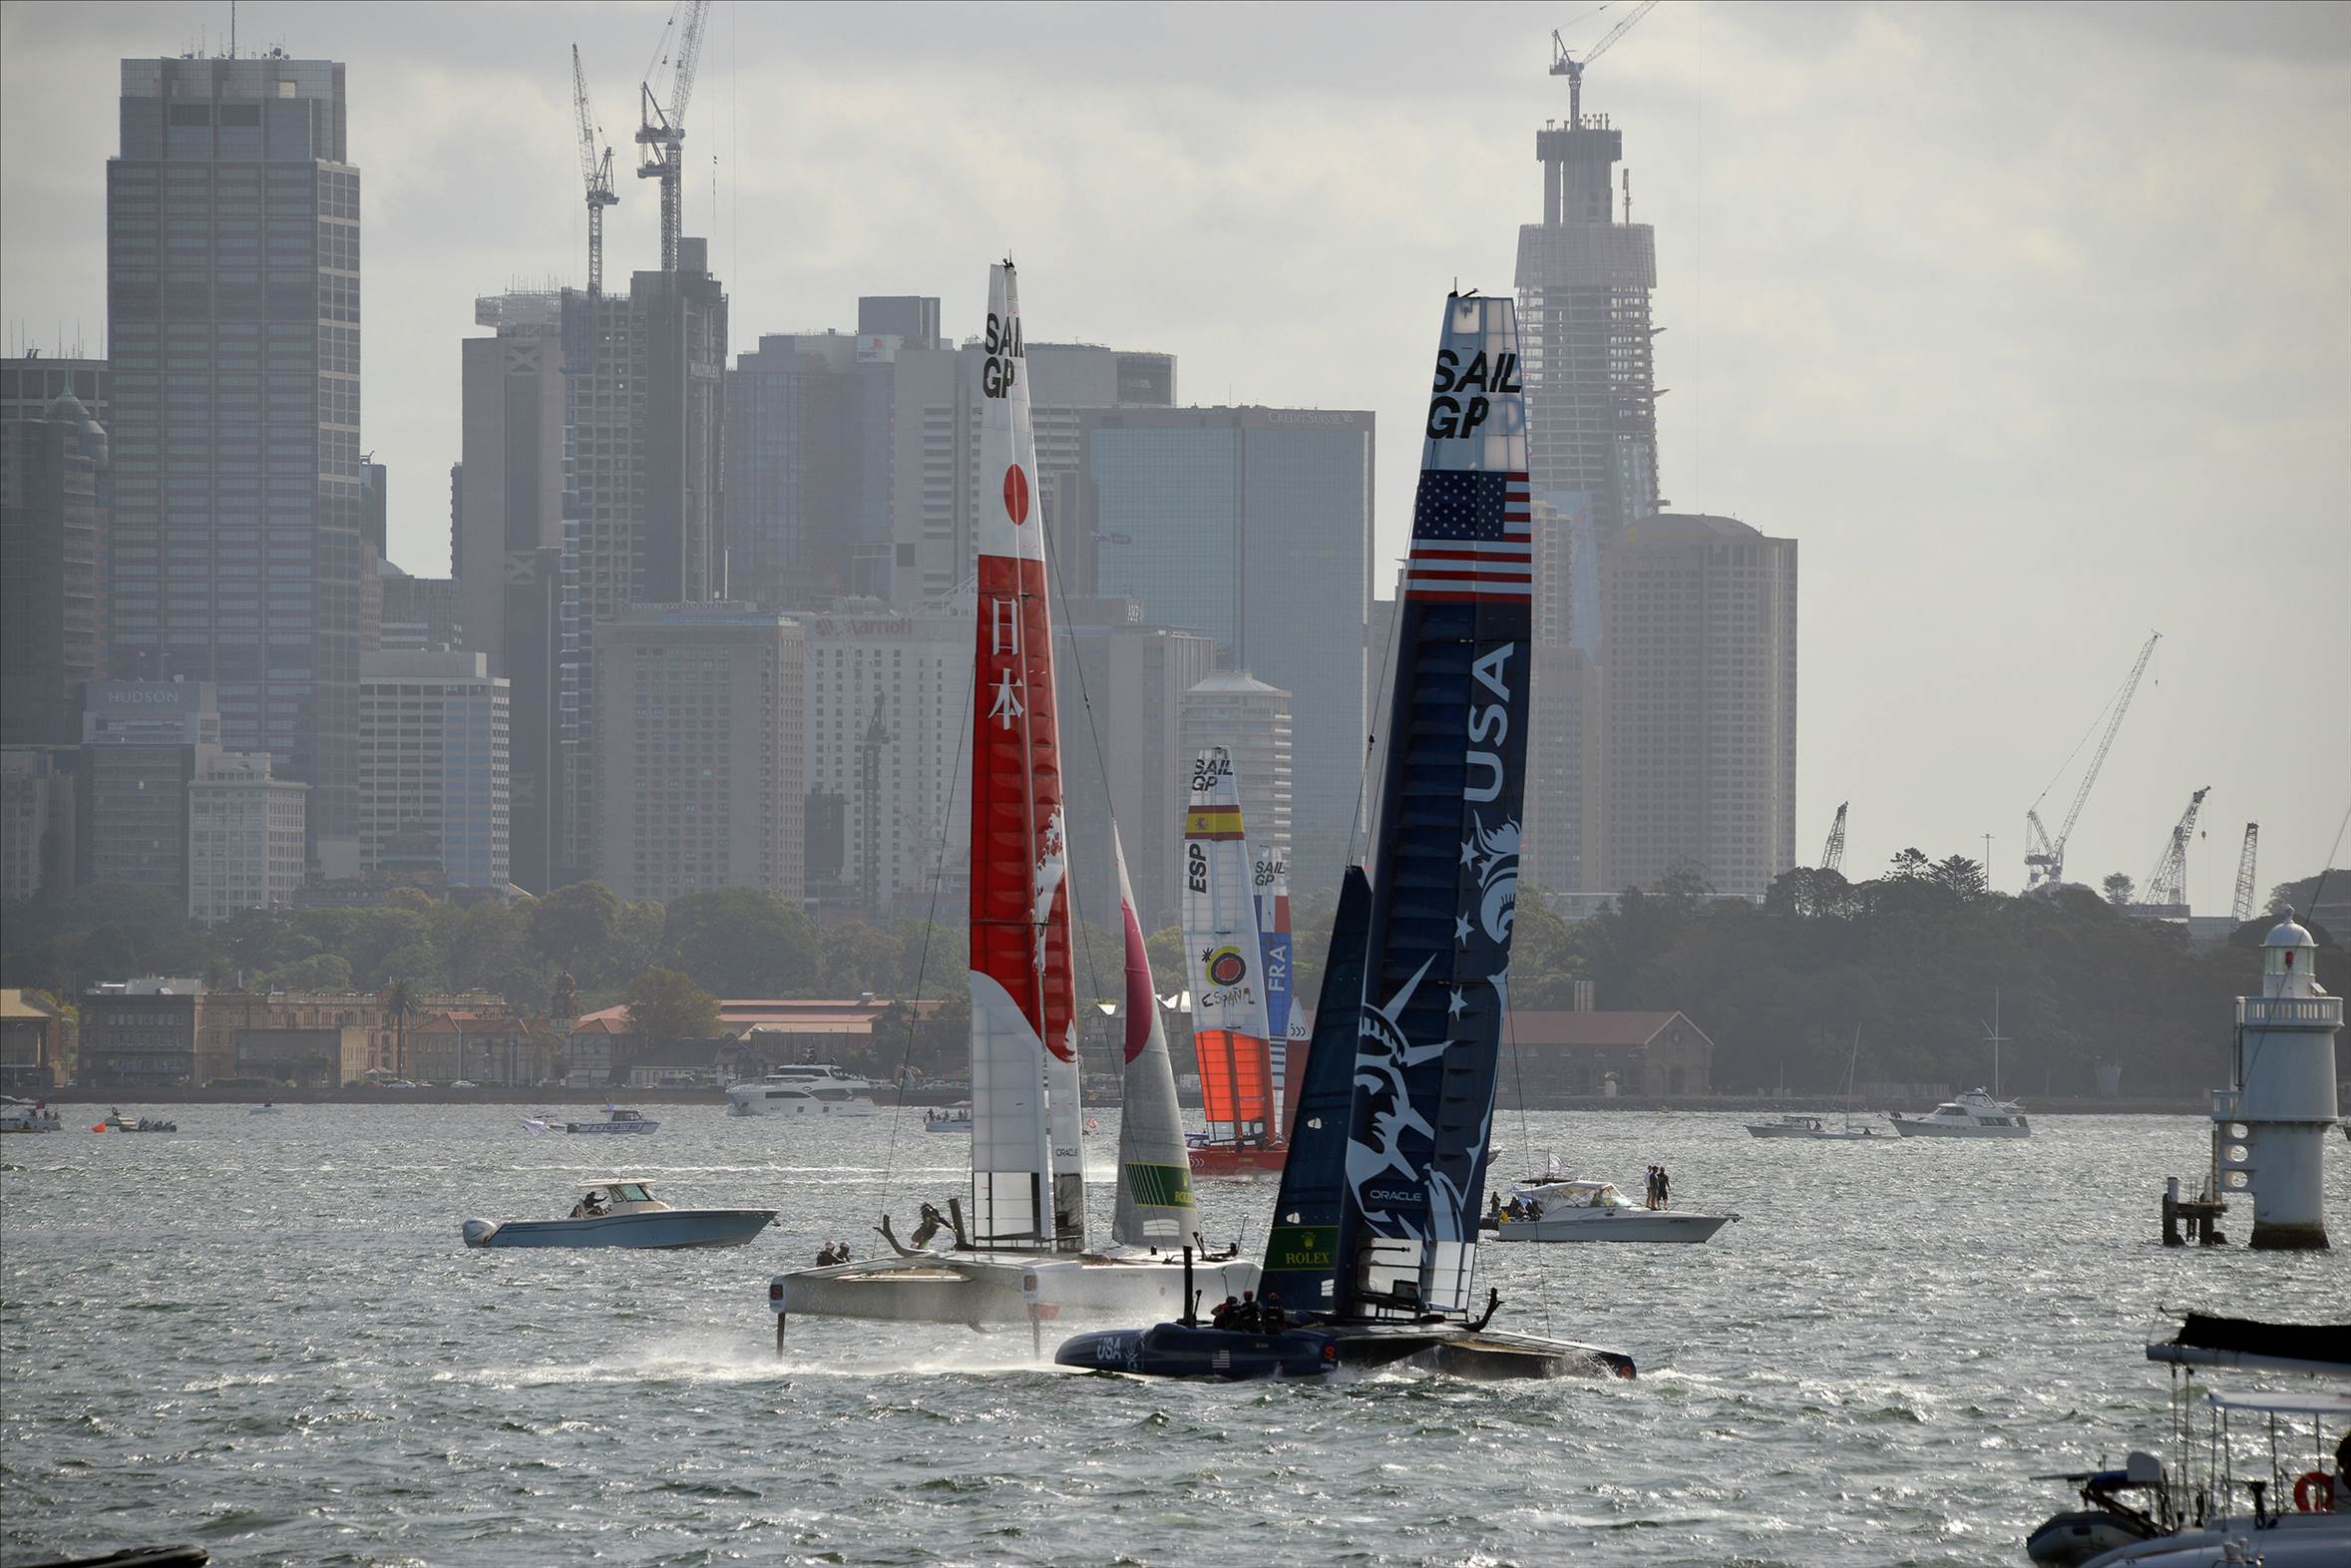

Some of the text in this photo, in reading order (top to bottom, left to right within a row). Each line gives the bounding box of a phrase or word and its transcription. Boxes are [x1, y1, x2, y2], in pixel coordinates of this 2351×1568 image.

[985, 313, 1024, 357] SAIL
[982, 357, 1014, 399] GP
[1432, 349, 1522, 393] SAIL
[1268, 411, 1342, 424] CREDIT SUISSE
[1426, 396, 1489, 439] GP
[987, 597, 1024, 730] 日本
[108, 690, 179, 703] HUDSON
[1463, 641, 1514, 802] USA
[1194, 759, 1234, 775] SAIL
[1192, 776, 1218, 791] GP
[1189, 843, 1206, 894] ESP
[1255, 861, 1286, 875] SAIL
[1255, 874, 1275, 887] GP
[1269, 945, 1286, 991] FRA
[1055, 1148, 1078, 1157] ORACLE
[1370, 1189, 1421, 1202] ORACLE
[1285, 1252, 1330, 1264] ROLEX
[1096, 1337, 1121, 1361] USA
